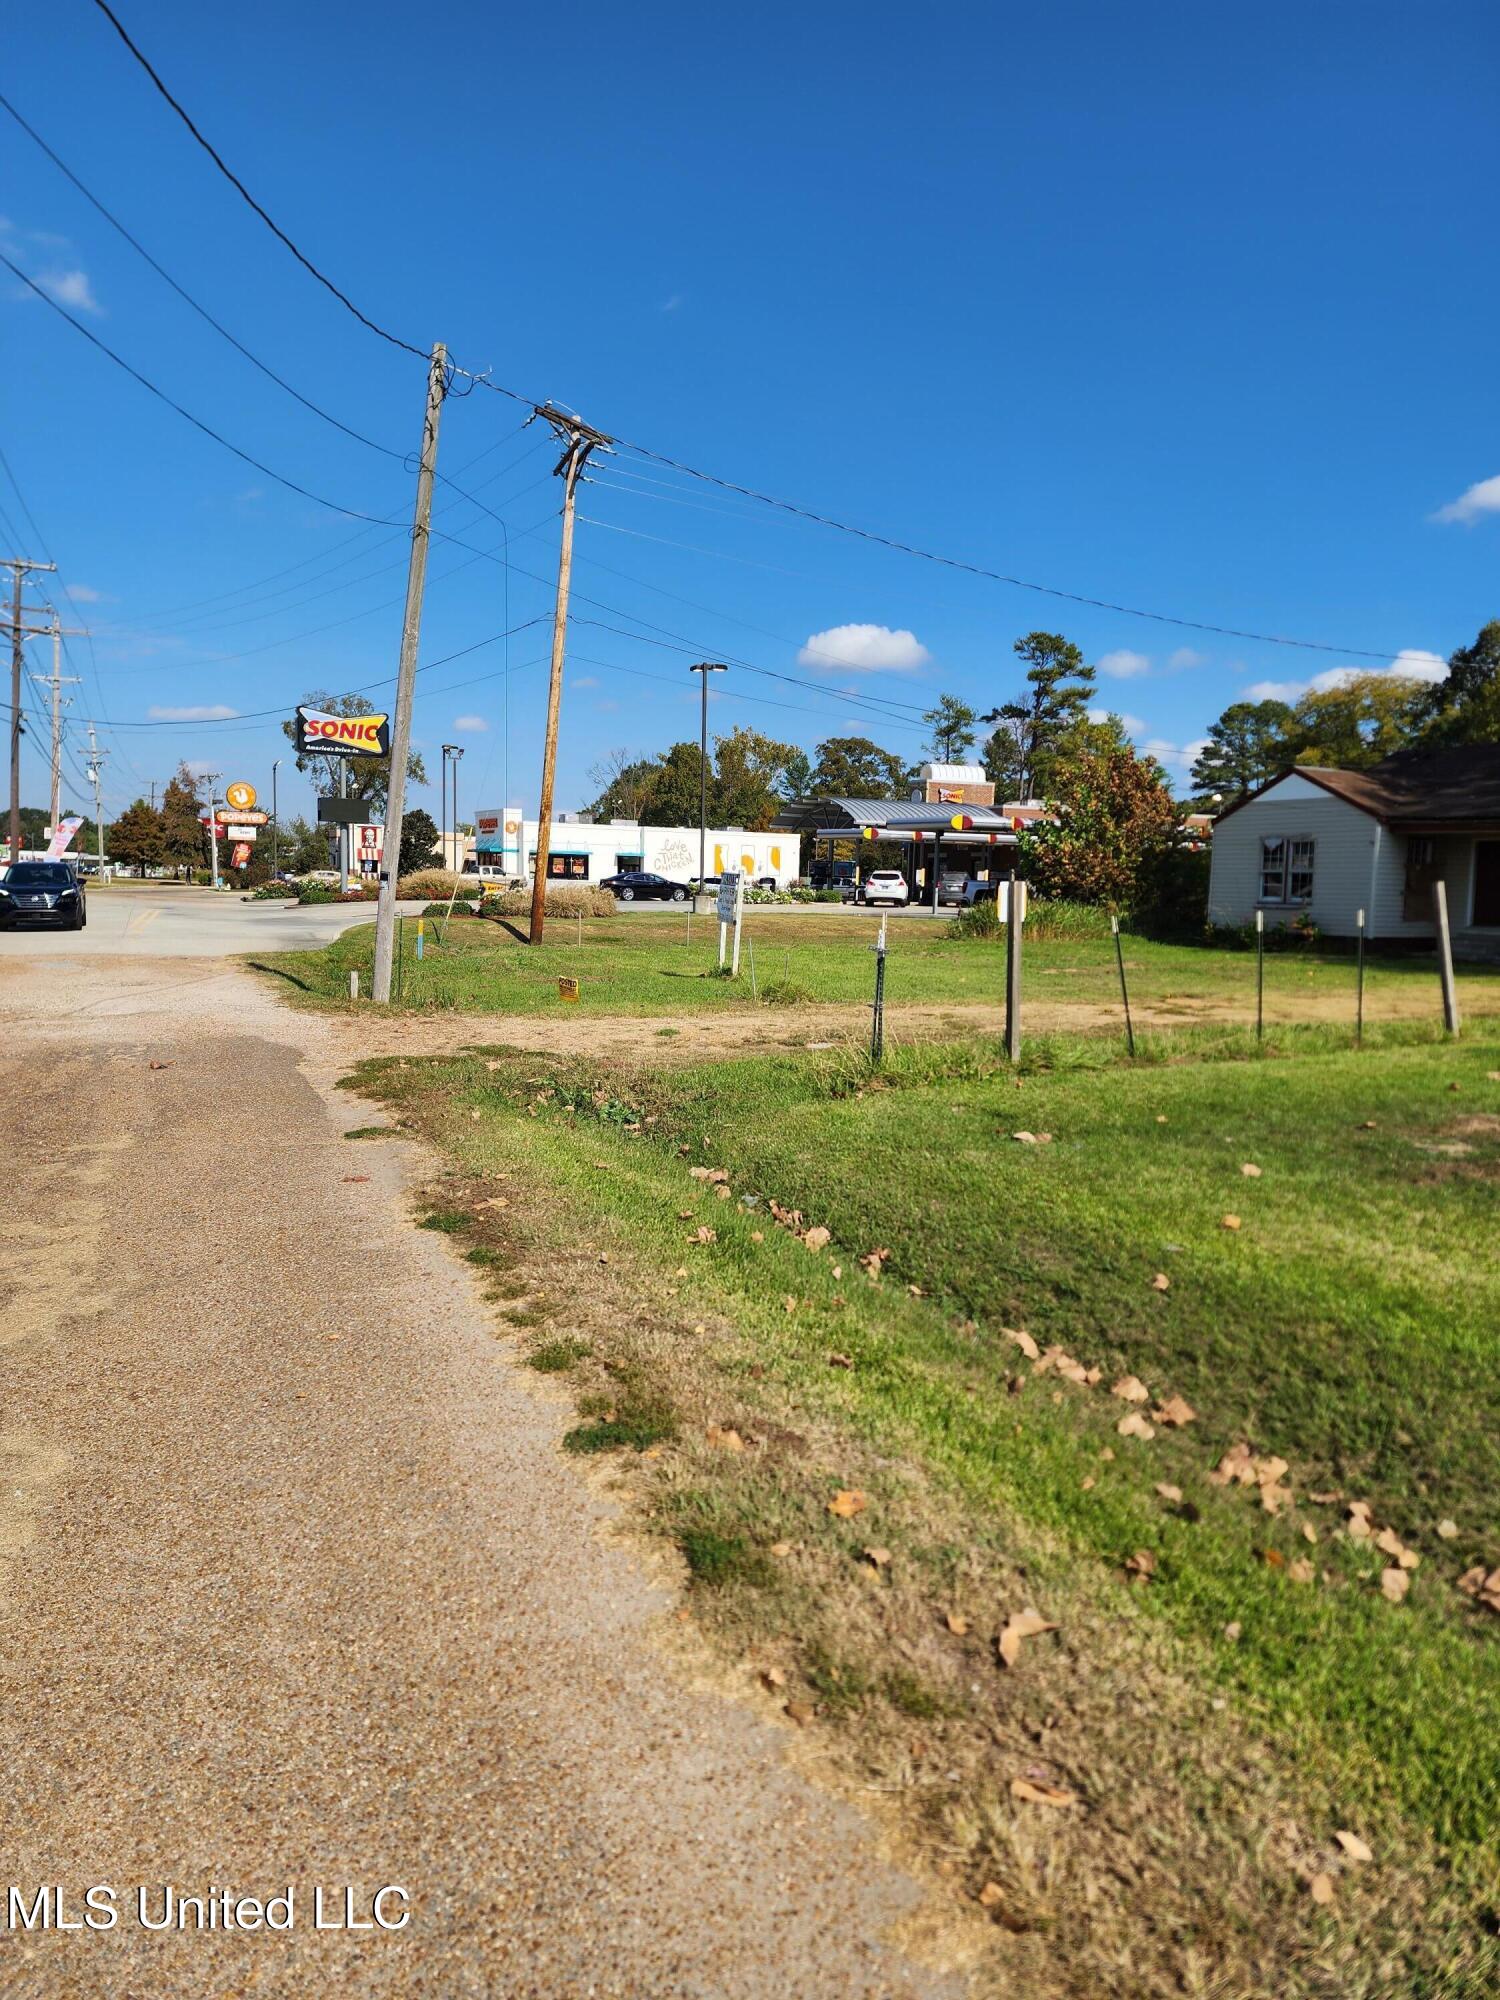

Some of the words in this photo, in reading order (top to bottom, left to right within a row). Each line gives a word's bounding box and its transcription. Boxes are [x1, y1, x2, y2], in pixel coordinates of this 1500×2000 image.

[305, 720, 380, 741] SONIC
[306, 744, 334, 752] America's
[943, 792, 963, 800] SONIC
